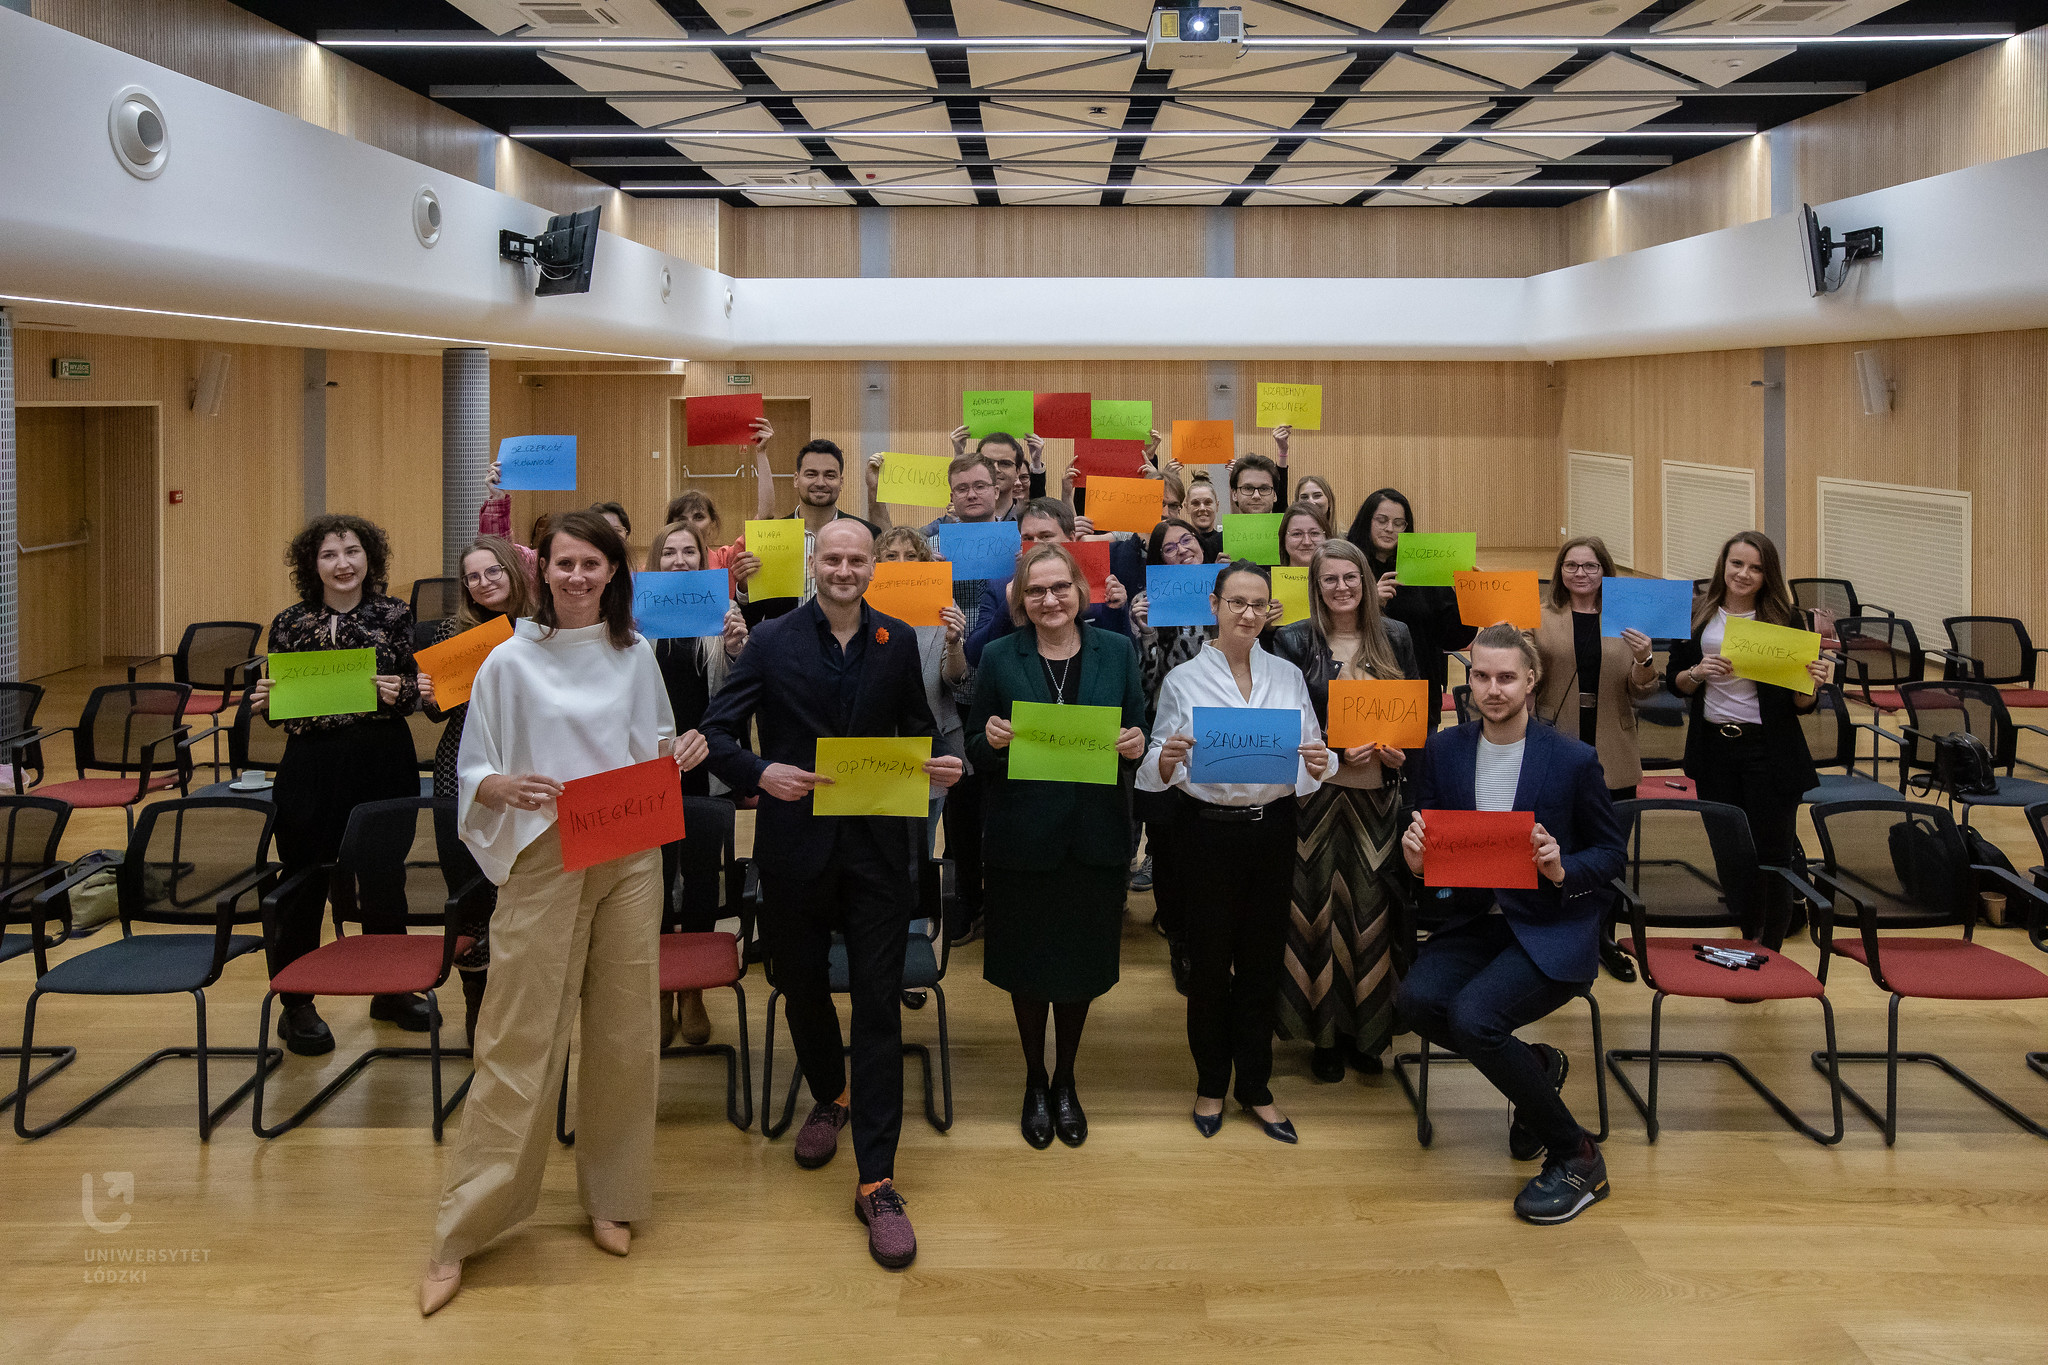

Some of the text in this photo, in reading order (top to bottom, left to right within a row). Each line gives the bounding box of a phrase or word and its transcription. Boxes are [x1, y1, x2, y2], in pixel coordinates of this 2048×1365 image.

[1458, 579, 1511, 592] POMOC
[638, 590, 717, 608] PRAWDA
[1729, 636, 1799, 661] SZACUNEK
[1342, 696, 1418, 724] PRAWDA
[1031, 729, 1111, 752] SZACUNEK
[1202, 730, 1283, 750] SZACUNEK
[836, 756, 915, 779] OPTYMIZM
[570, 791, 667, 835] INTEGRITY
